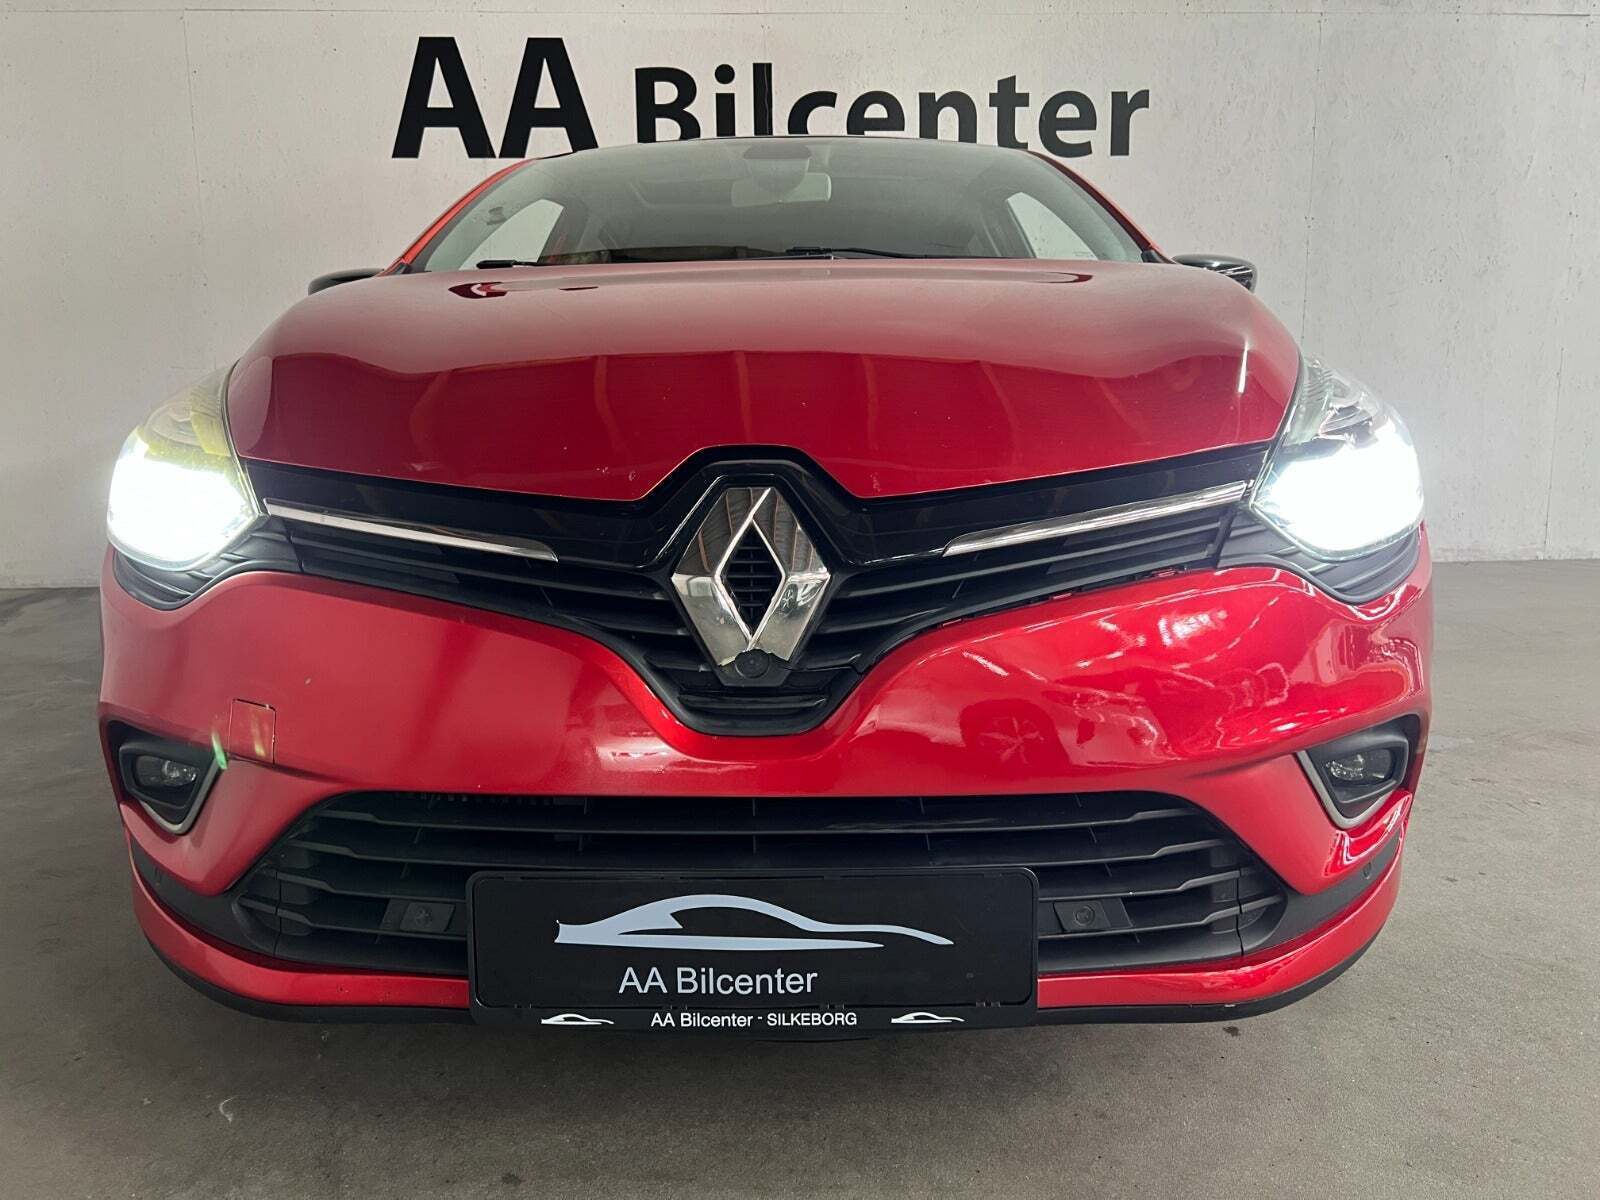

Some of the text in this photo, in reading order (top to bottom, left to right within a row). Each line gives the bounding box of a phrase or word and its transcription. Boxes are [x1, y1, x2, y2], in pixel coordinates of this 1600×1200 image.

[392, 37, 1149, 159] AA Bilcenter
[619, 967, 818, 994] AA Bilcenter
[651, 1012, 676, 1027] AA
[681, 1012, 754, 1027] Bilcenter
[767, 1012, 858, 1027] SILKEBORG
